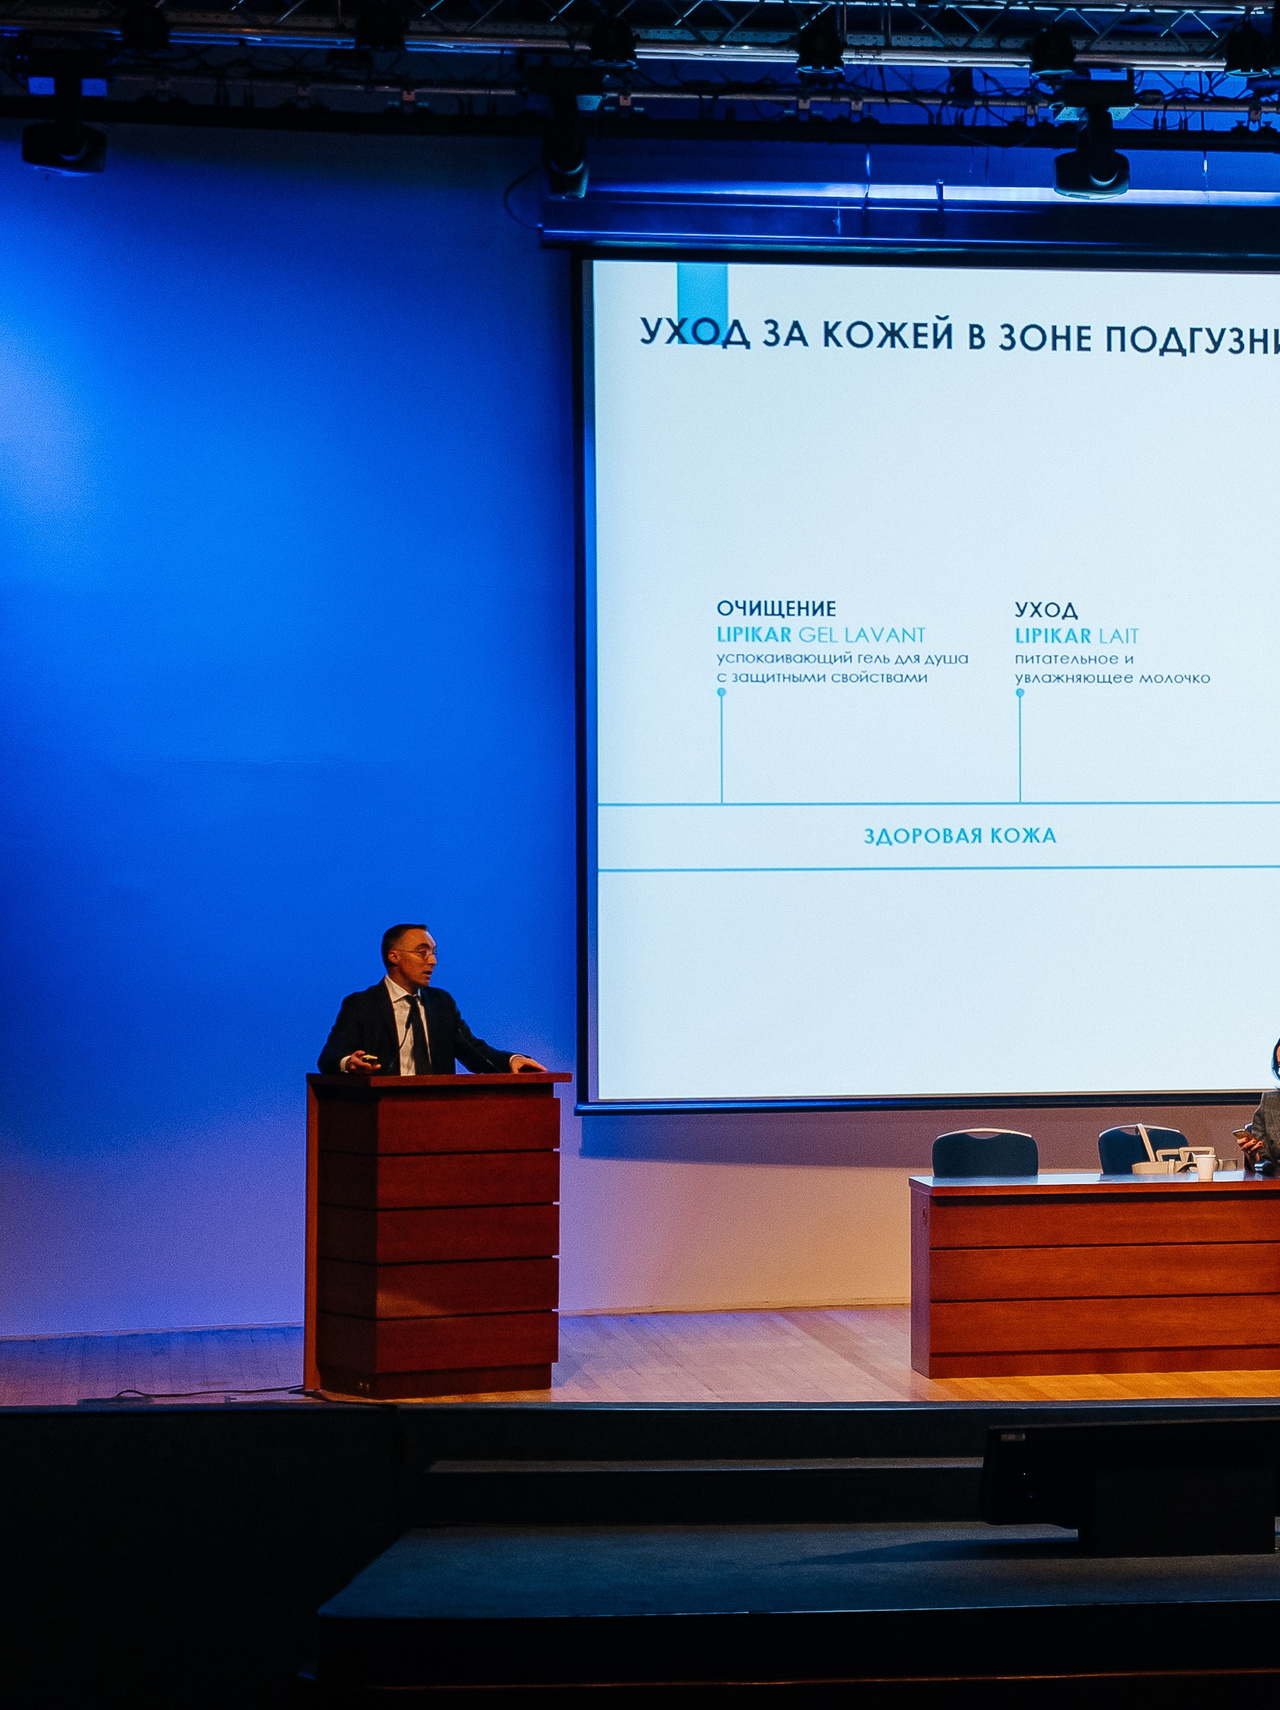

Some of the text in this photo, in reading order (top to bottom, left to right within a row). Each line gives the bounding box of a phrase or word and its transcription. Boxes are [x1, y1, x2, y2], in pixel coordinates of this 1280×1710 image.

[640, 316, 751, 350] УХОД
[762, 319, 809, 347] ЗА
[823, 315, 953, 350] КОЖЕЙ
[968, 323, 986, 349] В
[998, 323, 1092, 352] ЗОНЕ
[716, 599, 836, 619] ОЧИЩЕНИЕ
[1014, 601, 1079, 620] УХОД
[717, 626, 926, 644] LIPIKAR GEL LAVANT
[1015, 627, 1140, 644] LIPIKAR LAIT
[716, 650, 969, 667] успокаивающий гель для душа
[1015, 654, 1135, 665] питательное и
[716, 670, 928, 685] с защитными свойствами
[1014, 673, 1211, 687] увлажняющее молочко
[864, 827, 1057, 846] ЗДОРОВАЯ КОЖА
